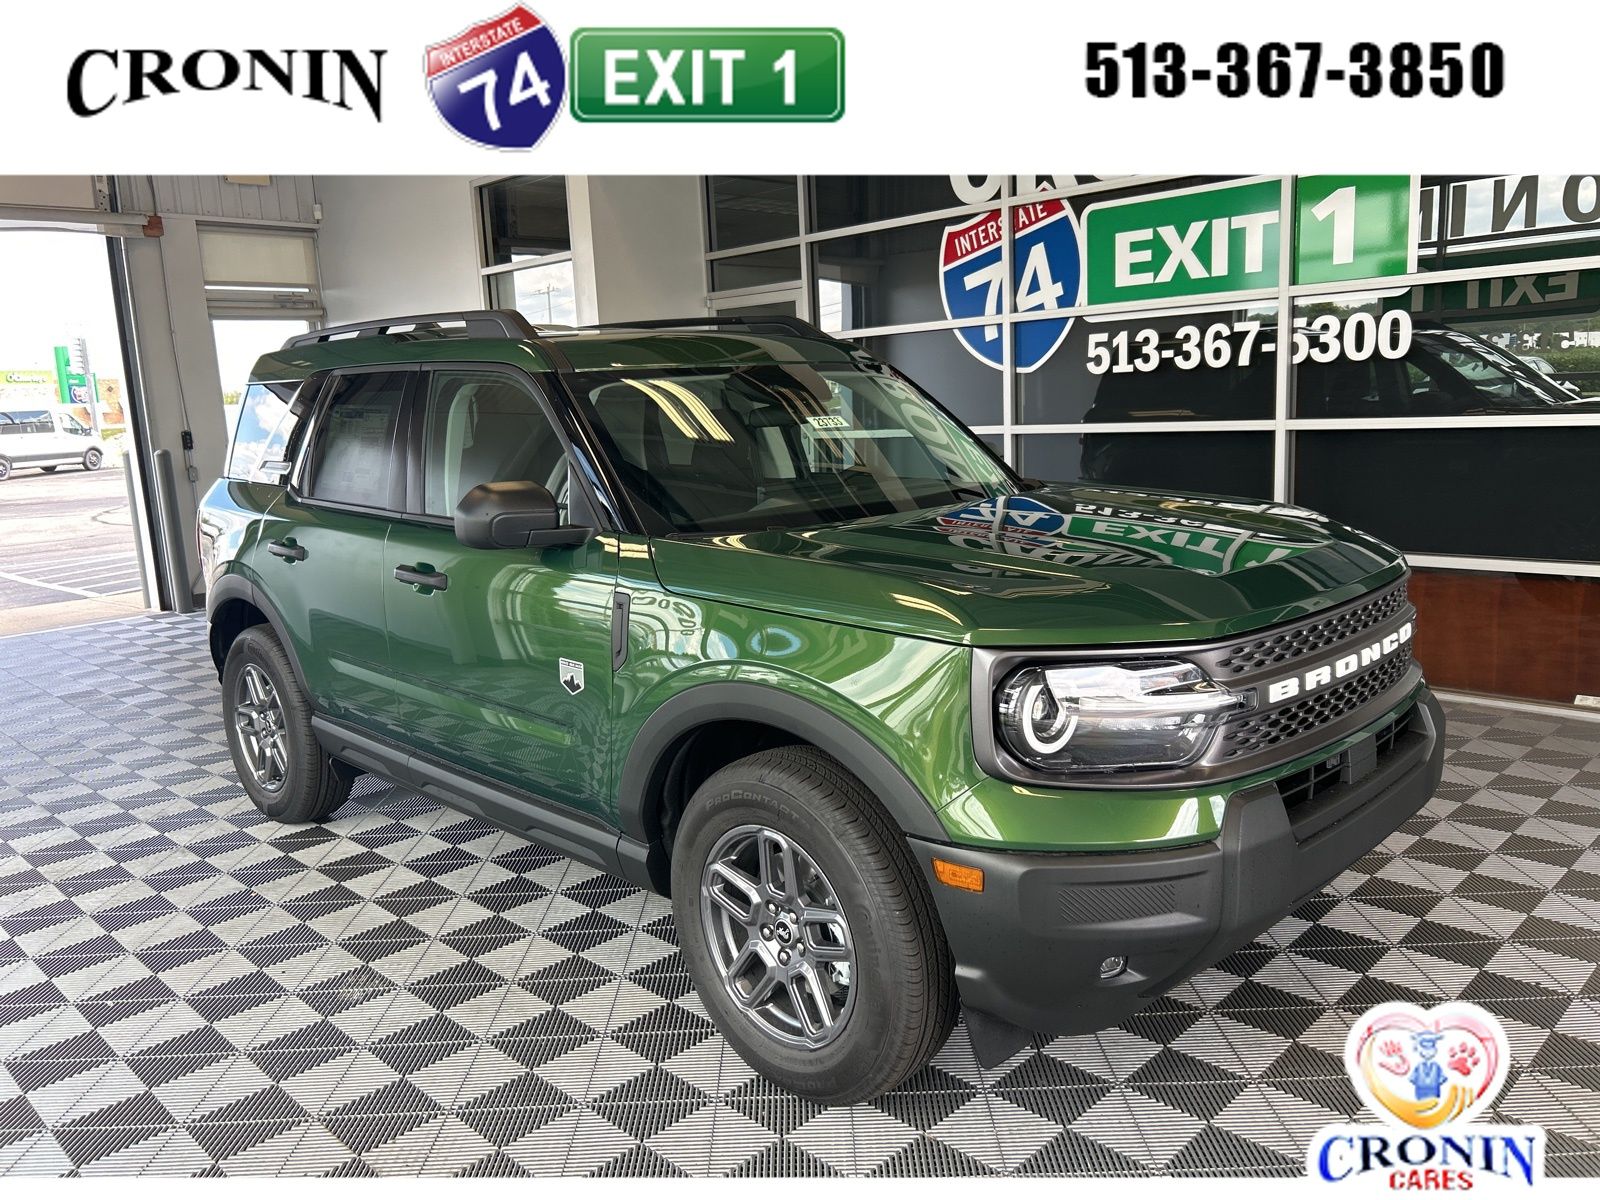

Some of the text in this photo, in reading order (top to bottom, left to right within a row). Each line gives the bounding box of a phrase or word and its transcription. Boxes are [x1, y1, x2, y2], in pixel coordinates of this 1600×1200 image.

[1115, 186, 1356, 288] EXIT 1
[964, 242, 1064, 342] 74
[1086, 309, 1412, 375] 513-367-5300
[1269, 622, 1412, 703] BRONCO
